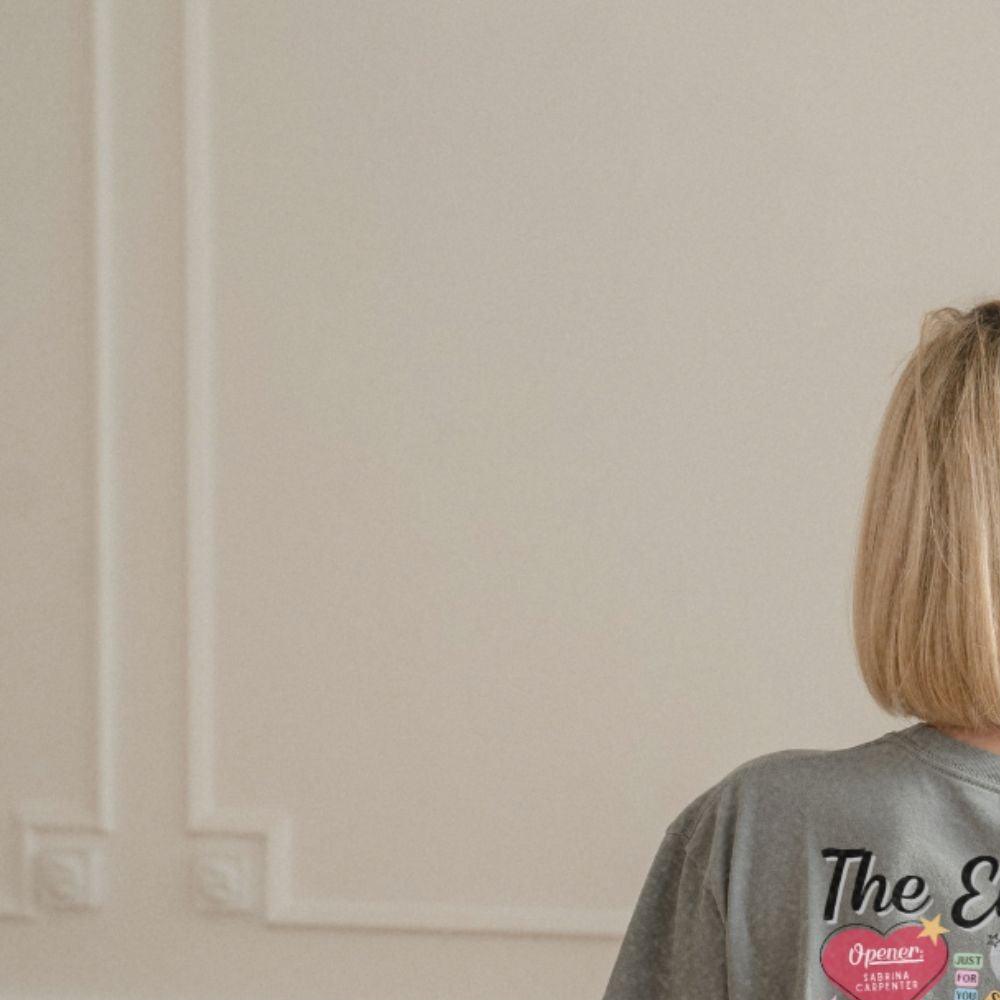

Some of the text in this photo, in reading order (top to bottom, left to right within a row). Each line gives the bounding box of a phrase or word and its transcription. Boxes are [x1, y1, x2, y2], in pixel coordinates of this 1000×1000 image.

[821, 848, 932, 922] The
[955, 956, 982, 965] JUST
[863, 971, 910, 982] SABRINA
[957, 974, 977, 983] FOR
[855, 980, 919, 992] CARPENTER
[956, 991, 977, 1000] YOU
